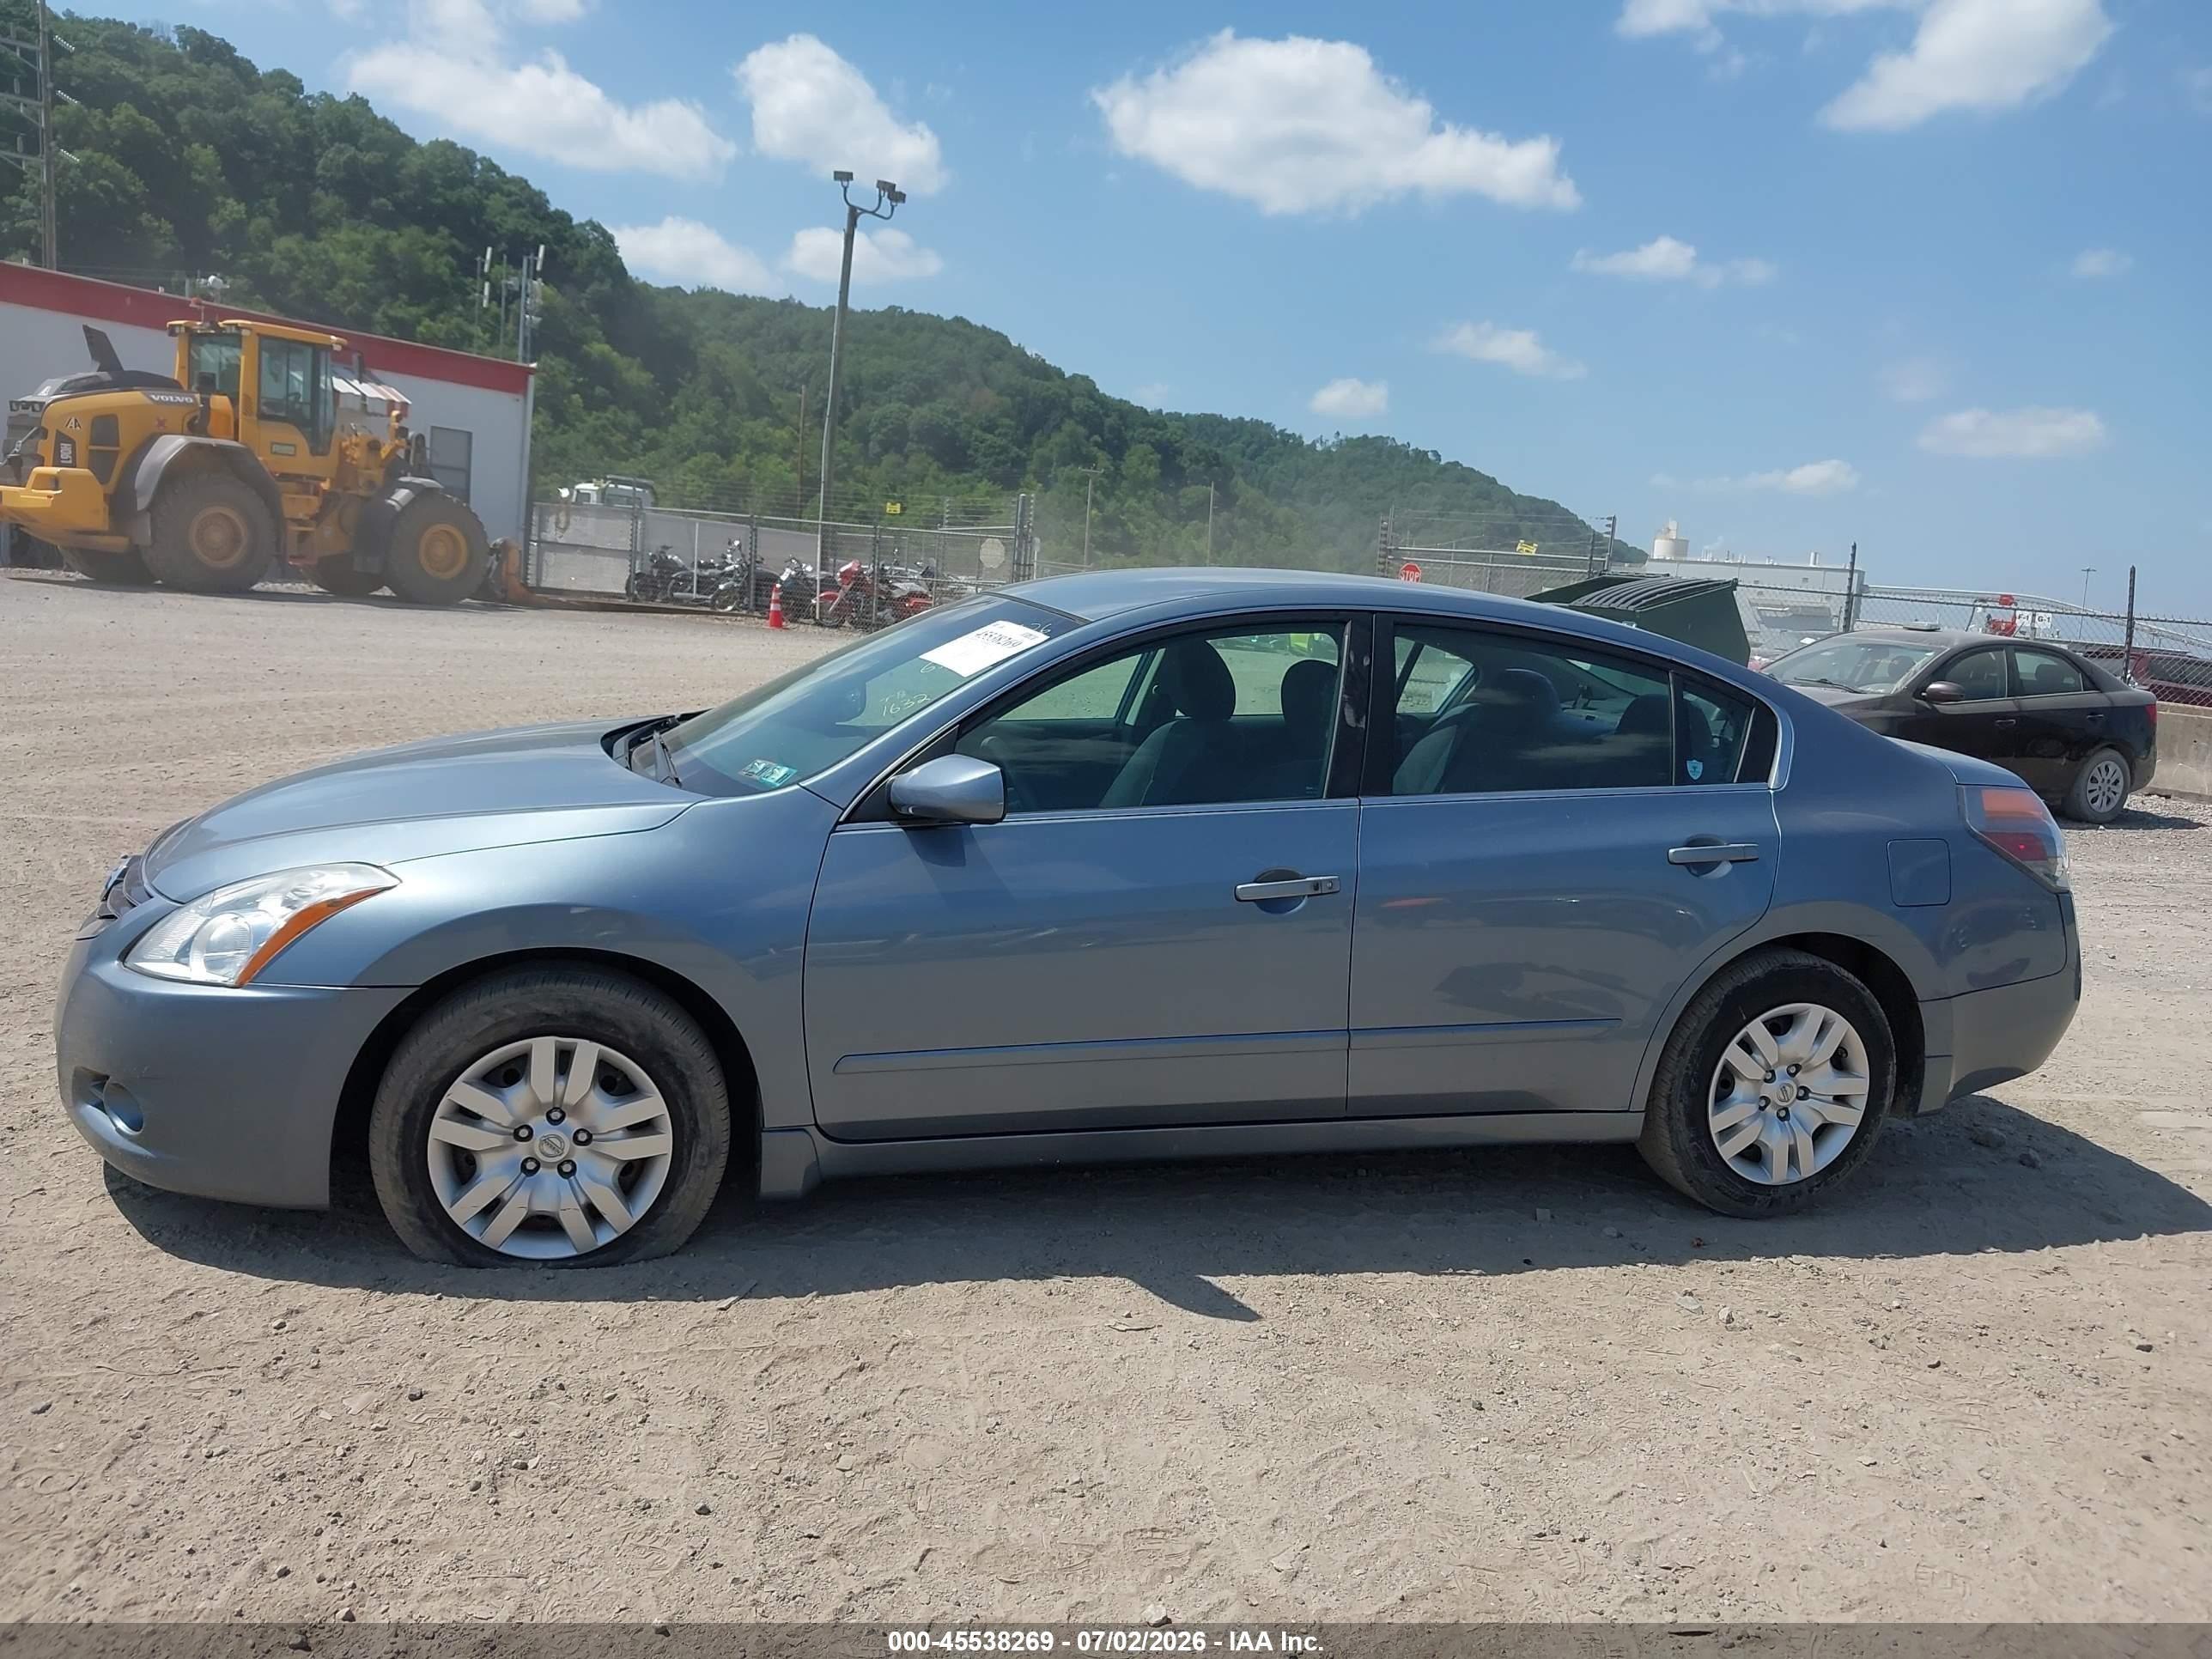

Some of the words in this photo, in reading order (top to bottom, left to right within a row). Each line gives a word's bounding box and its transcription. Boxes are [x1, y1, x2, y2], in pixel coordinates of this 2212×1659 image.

[150, 394, 193, 404] VOLVO
[60, 442, 72, 464] L90H
[1401, 569, 1420, 582] STOP
